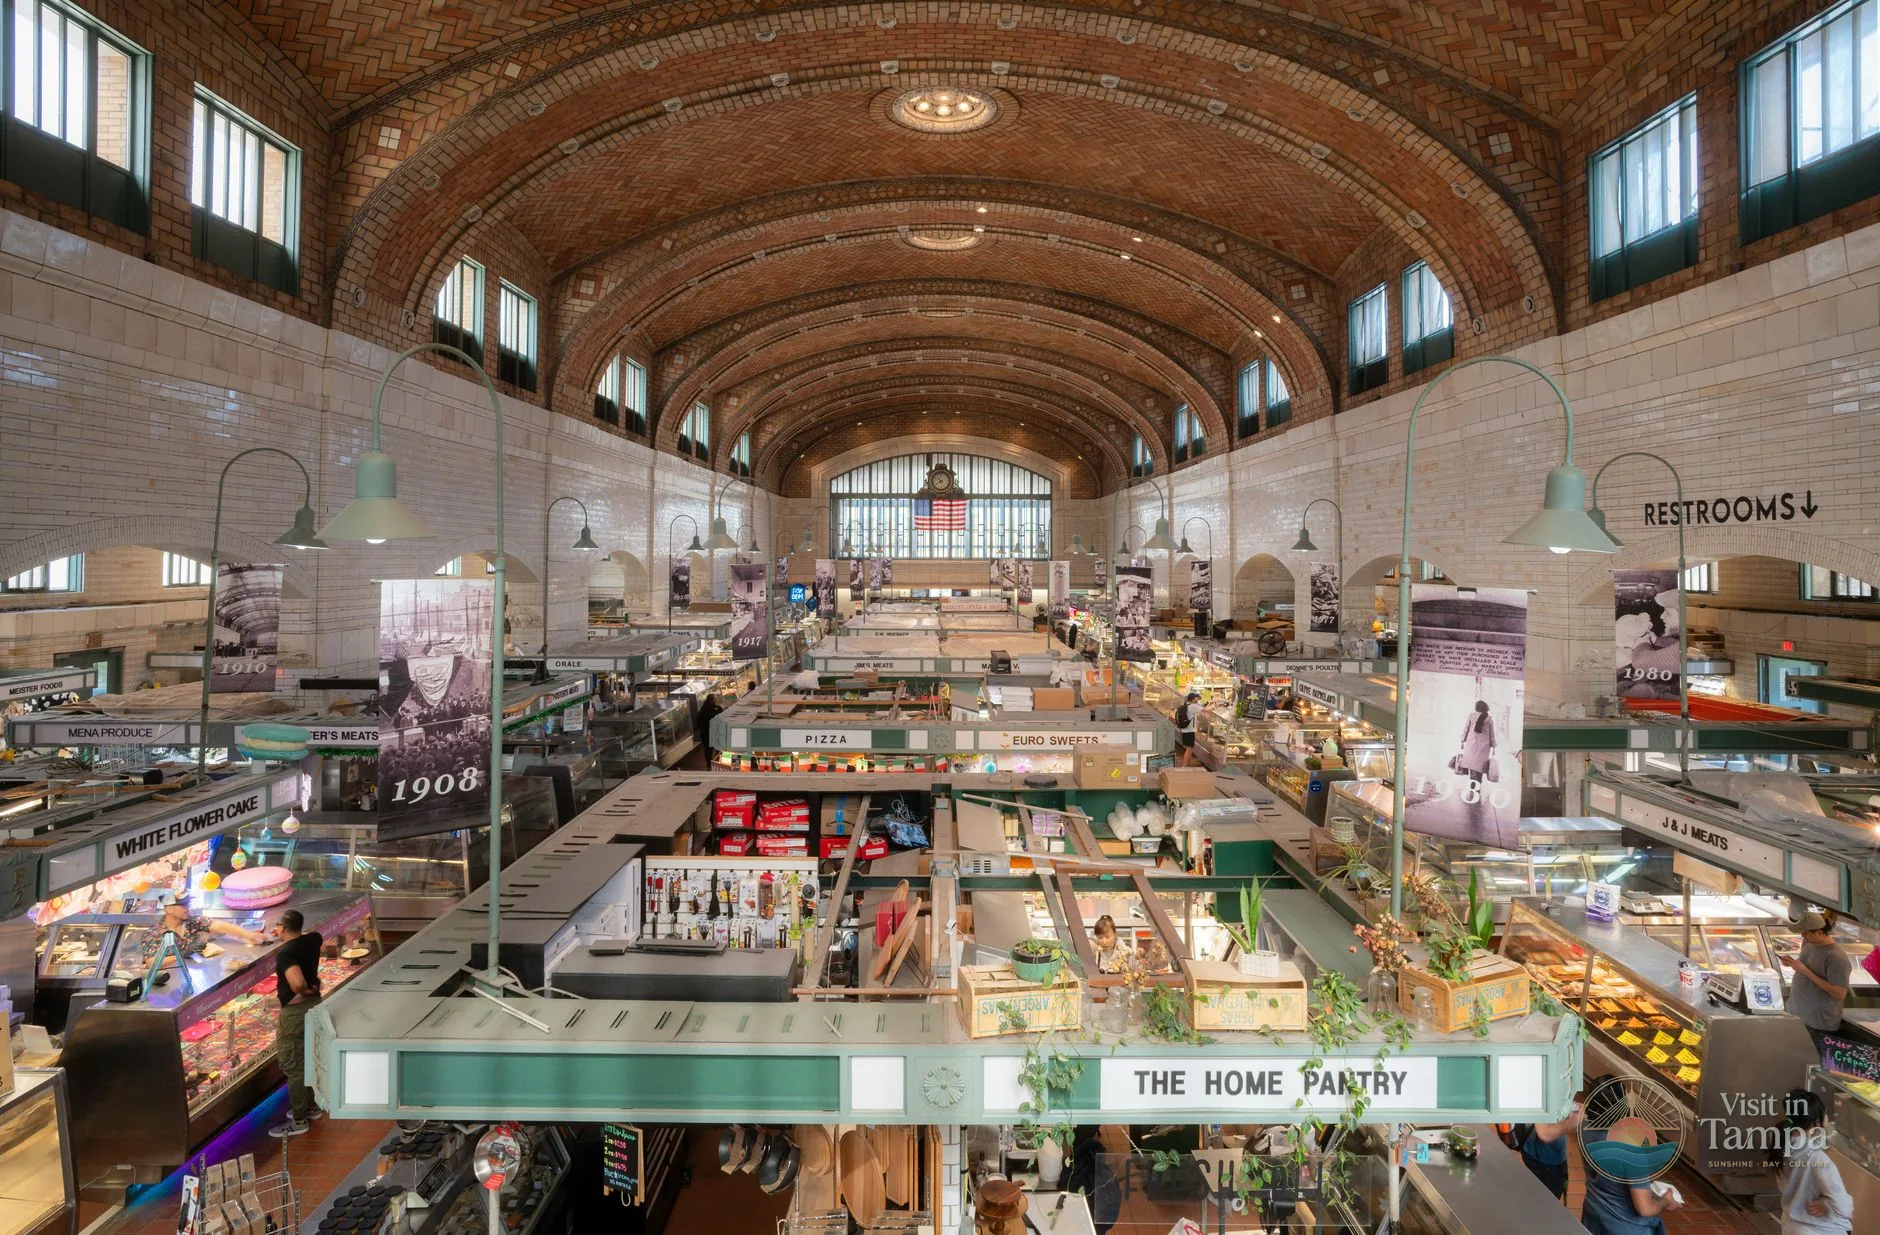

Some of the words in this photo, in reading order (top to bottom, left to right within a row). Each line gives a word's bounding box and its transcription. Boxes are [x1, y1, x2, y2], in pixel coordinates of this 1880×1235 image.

[1644, 492, 1796, 526] RESTROOMS
[737, 636, 762, 648] 1917
[218, 662, 268, 676] 1910
[555, 660, 582, 668] ORALE
[1623, 667, 1673, 682] 1980
[9, 684, 39, 696] MEISTER
[40, 681, 63, 692] FOODS
[68, 728, 99, 738] MENA
[100, 728, 153, 738] PRODUCE
[309, 731, 339, 740] ER'S
[341, 731, 379, 741] MEATS
[805, 734, 848, 745] PIZZA
[1013, 735, 1045, 746] EURO
[1049, 735, 1099, 746] SWEETS
[391, 766, 478, 804] 1908
[115, 827, 166, 859] WHITE
[168, 807, 225, 841] FLOWER
[225, 795, 259, 819] CAKE
[1662, 816, 1669, 829] J
[1670, 819, 1678, 832] &
[1681, 823, 1687, 835] J
[1690, 826, 1729, 851] MEATS
[1823, 1036, 1853, 1050] Order
[1134, 1070, 1186, 1096] THE
[1204, 1070, 1283, 1096] HOME
[1303, 1070, 1408, 1096] PANTRY
